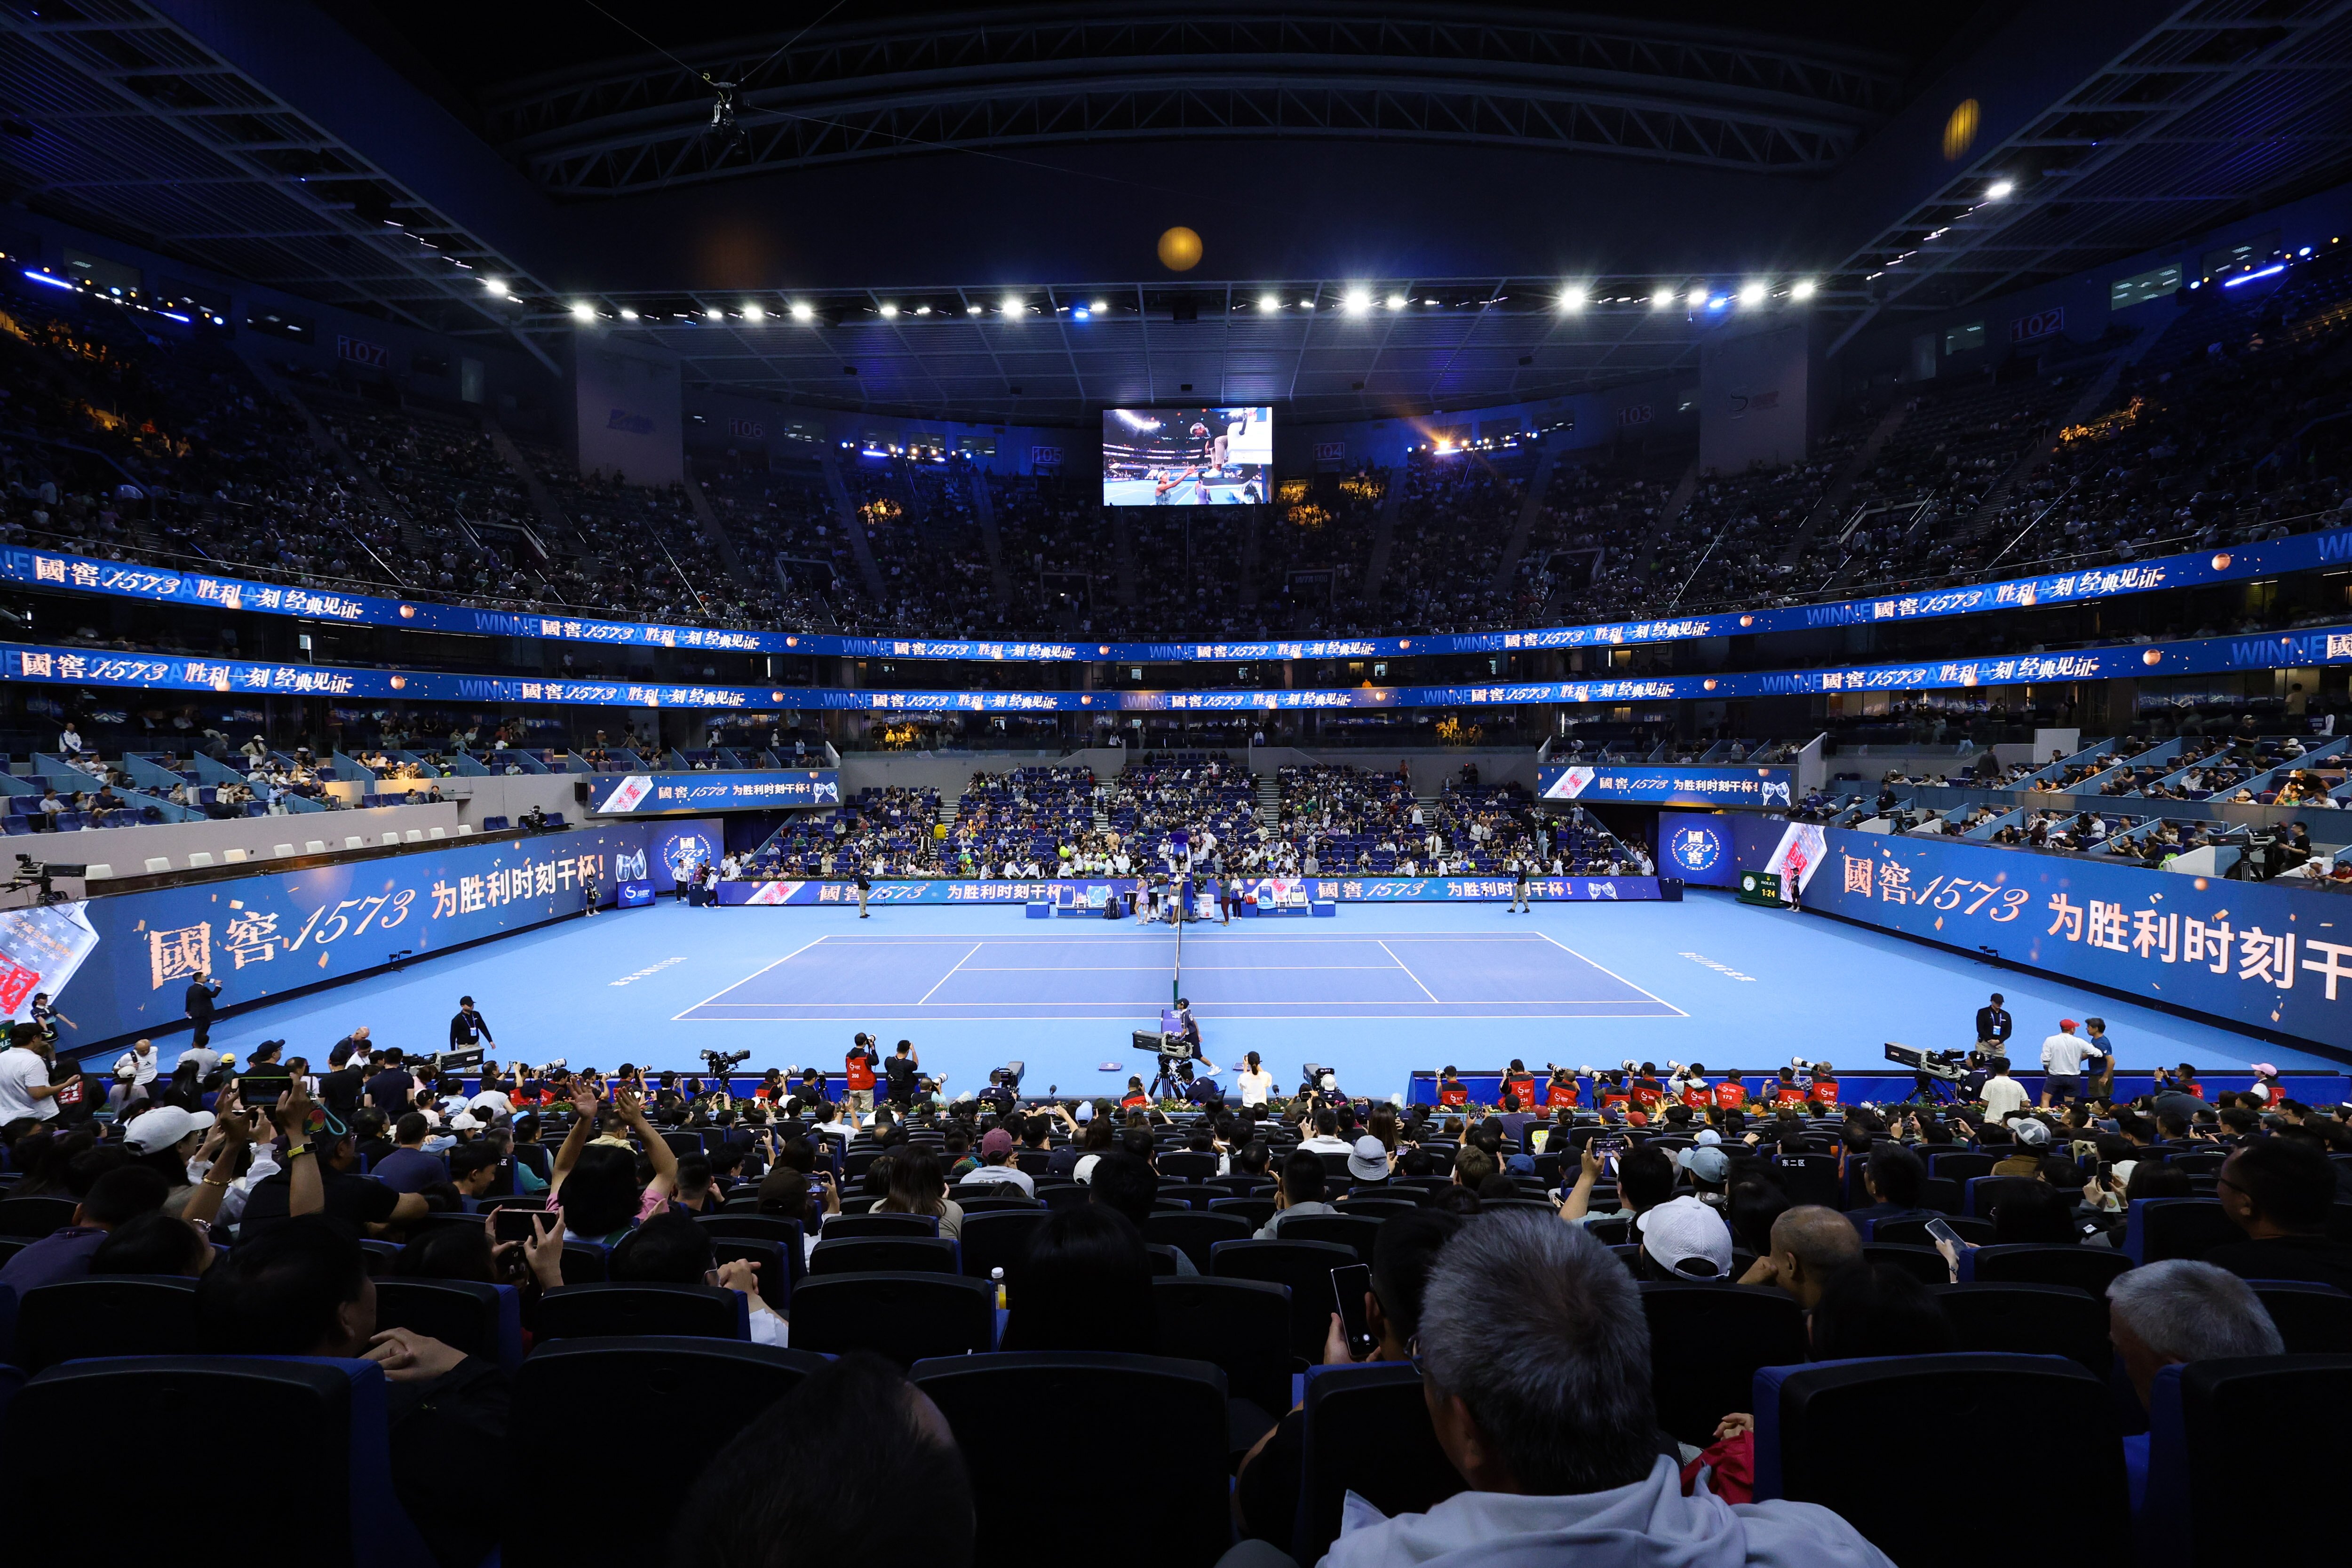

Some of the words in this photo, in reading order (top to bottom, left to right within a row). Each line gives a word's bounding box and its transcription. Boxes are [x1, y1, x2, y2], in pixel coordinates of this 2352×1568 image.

[2013, 311, 2060, 339] 102
[342, 338, 386, 365] 107
[1619, 406, 1652, 423] 103
[731, 420, 763, 437] 106
[1035, 449, 1062, 462] 105
[1316, 444, 1342, 458] 104
[102, 570, 181, 594] 1573
[196, 579, 281, 608] 胜利一刻
[285, 589, 363, 619] 经典见证
[1920, 592, 1983, 613] 1573
[1996, 576, 2076, 603] 胜利一刻
[2079, 567, 2165, 593] 经典见证
[583, 625, 635, 640] 1573
[644, 627, 703, 645] 胜利一刻
[705, 630, 760, 650] 经典见证
[1539, 630, 1584, 645] 1573
[1594, 625, 1649, 641] 胜利一刻
[1652, 621, 1710, 637] 经典见证
[927, 645, 969, 655] 1573
[977, 644, 1025, 657] 胜利一刻
[1028, 644, 1076, 659] 经典见证
[1228, 645, 1269, 657] 1573
[1277, 643, 1324, 655] 胜利一刻
[1327, 641, 1375, 655] 经典见证
[88, 660, 168, 681] 1573
[184, 662, 270, 688] 胜利一刻
[275, 667, 353, 693] 经典见证
[1866, 669, 1927, 686] 1573
[1938, 661, 2015, 683] 胜利一刻
[2018, 656, 2100, 679] 经典见证
[564, 686, 617, 700] 1573
[627, 686, 686, 703] 胜利一刻
[689, 687, 745, 706] 经典见证
[1505, 688, 1551, 700] 1573
[1560, 684, 1615, 699] 胜利一刻
[1617, 681, 1675, 698] 经典见证
[906, 695, 949, 707] 1573
[958, 694, 1006, 707] 胜利一刻
[1009, 693, 1057, 709] 经典见证
[1203, 695, 1244, 706] 1573
[1252, 693, 1300, 707] 胜利一刻
[1302, 692, 1351, 707] 经典见证
[690, 785, 728, 797] 1573
[1629, 779, 1668, 789] 1573
[1678, 844, 1713, 852] 1573
[1706, 828, 1720, 851] CHINA
[670, 848, 705, 859] 1573
[867, 886, 926, 899] 1573
[1367, 882, 1425, 896] 1573
[1762, 889, 1776, 898] 1:24
[1915, 875, 2029, 922] 1573
[289, 889, 416, 951] 1573
